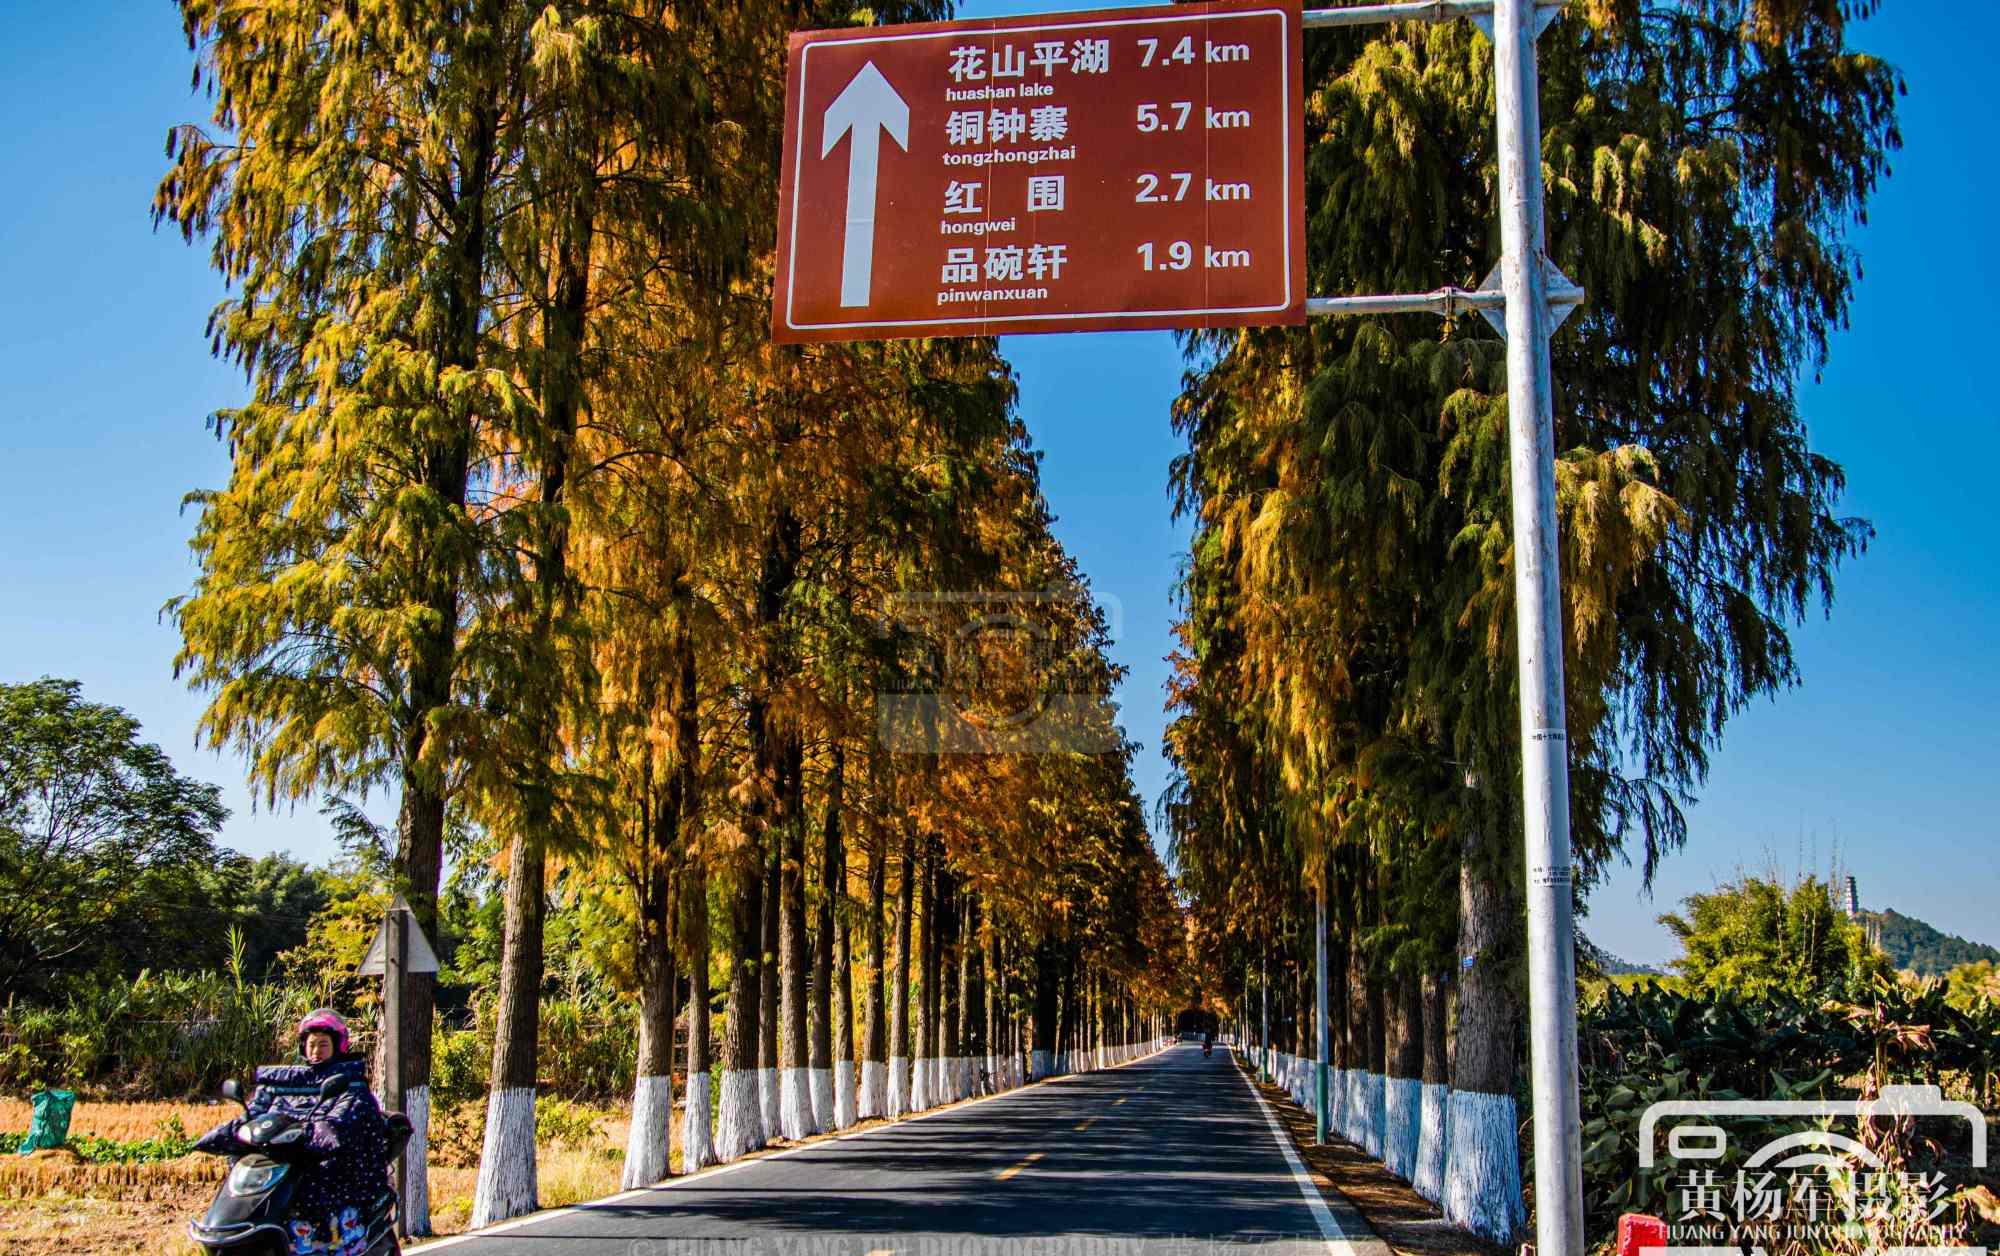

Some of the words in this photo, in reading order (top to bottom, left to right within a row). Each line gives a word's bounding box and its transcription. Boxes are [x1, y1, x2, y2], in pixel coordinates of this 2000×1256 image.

[948, 38, 1110, 83] 花山平湖
[1137, 35, 1196, 67] 7.4
[1205, 40, 1249, 63] km
[946, 85, 1016, 101] huashan
[1019, 82, 1054, 97] lake
[945, 105, 1069, 146] 铜钟寨
[1137, 101, 1192, 132] 5.7
[1205, 106, 1250, 128] km
[943, 145, 1076, 166] tongzhongzhai
[1136, 172, 1192, 202] 2.7
[1205, 178, 1250, 200] km
[940, 217, 1016, 235] hongwei
[941, 243, 1067, 283] 品碗轩
[1137, 240, 1192, 271] 1.9
[1204, 245, 1250, 268] km
[937, 287, 1048, 305] pinwanxuan
